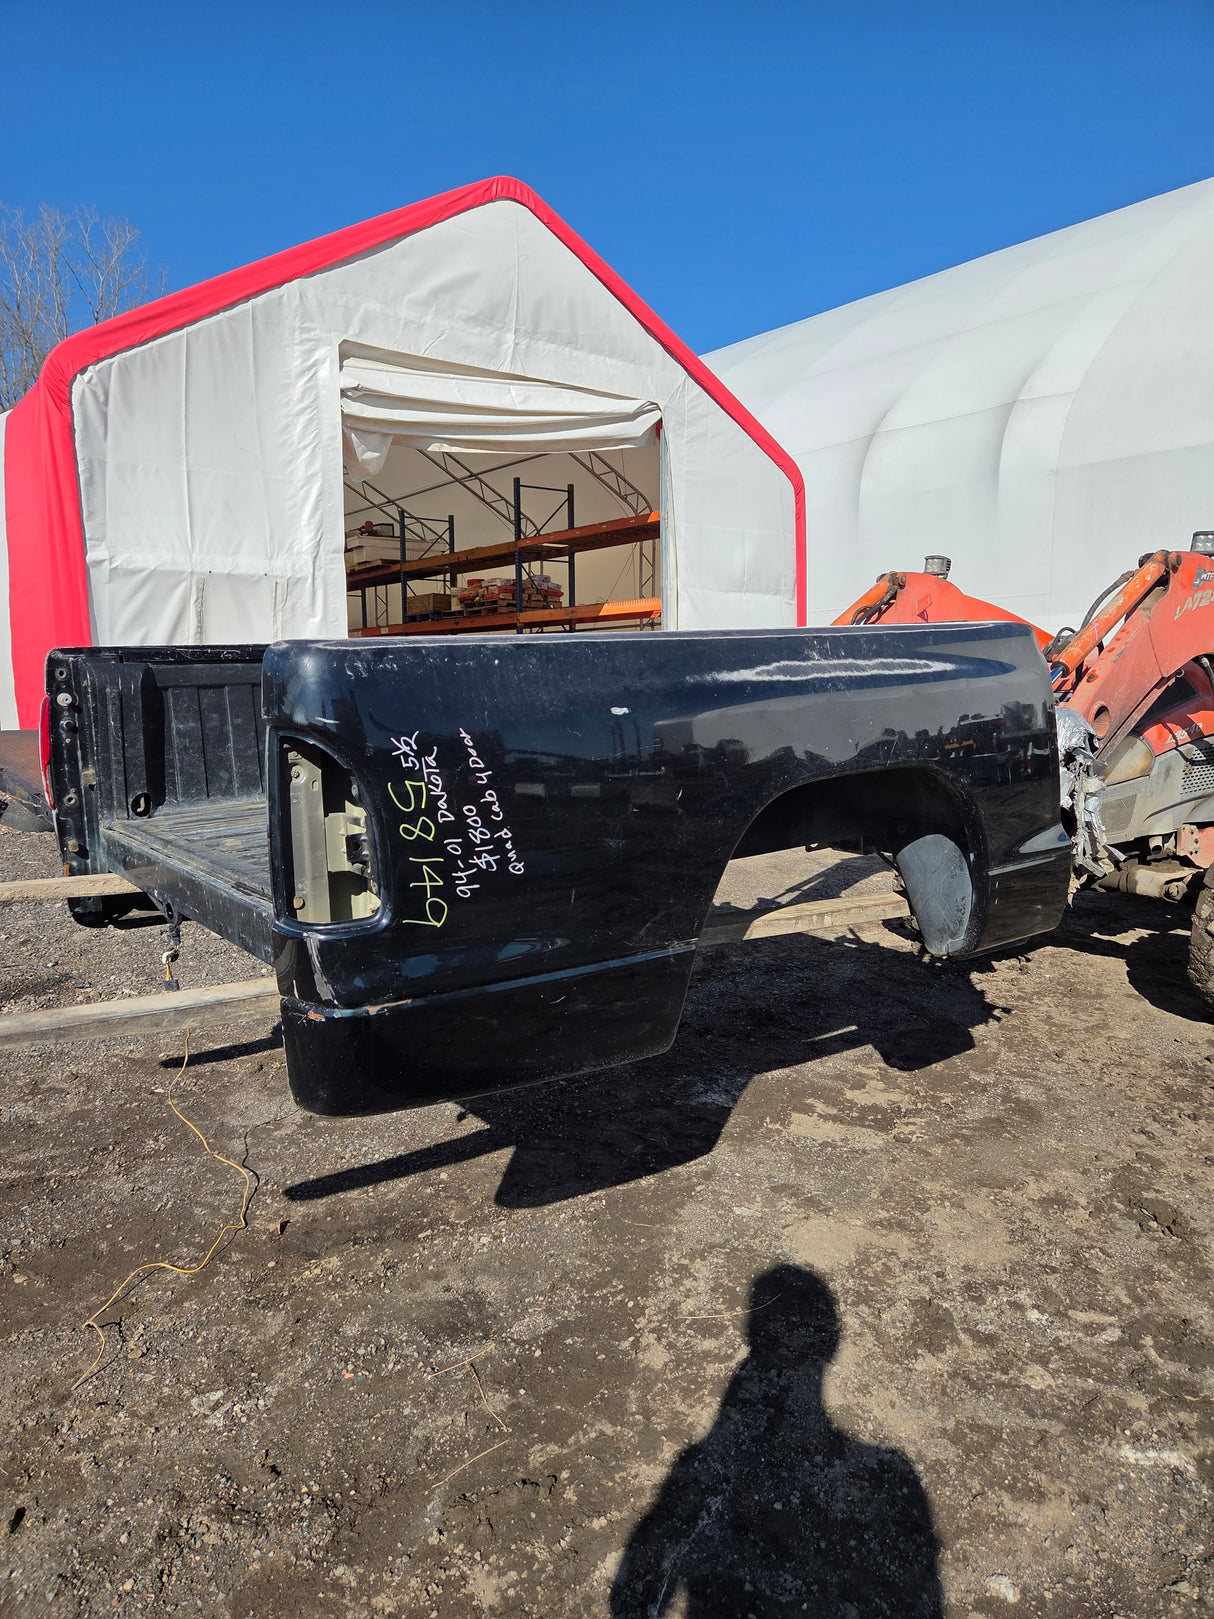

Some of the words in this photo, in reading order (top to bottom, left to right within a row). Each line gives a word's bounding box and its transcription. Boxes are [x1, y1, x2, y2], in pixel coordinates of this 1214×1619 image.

[1174, 589, 1214, 620] LA72
[475, 770, 493, 784] 4
[388, 780, 448, 928] 58149
[462, 805, 501, 872] $1800
